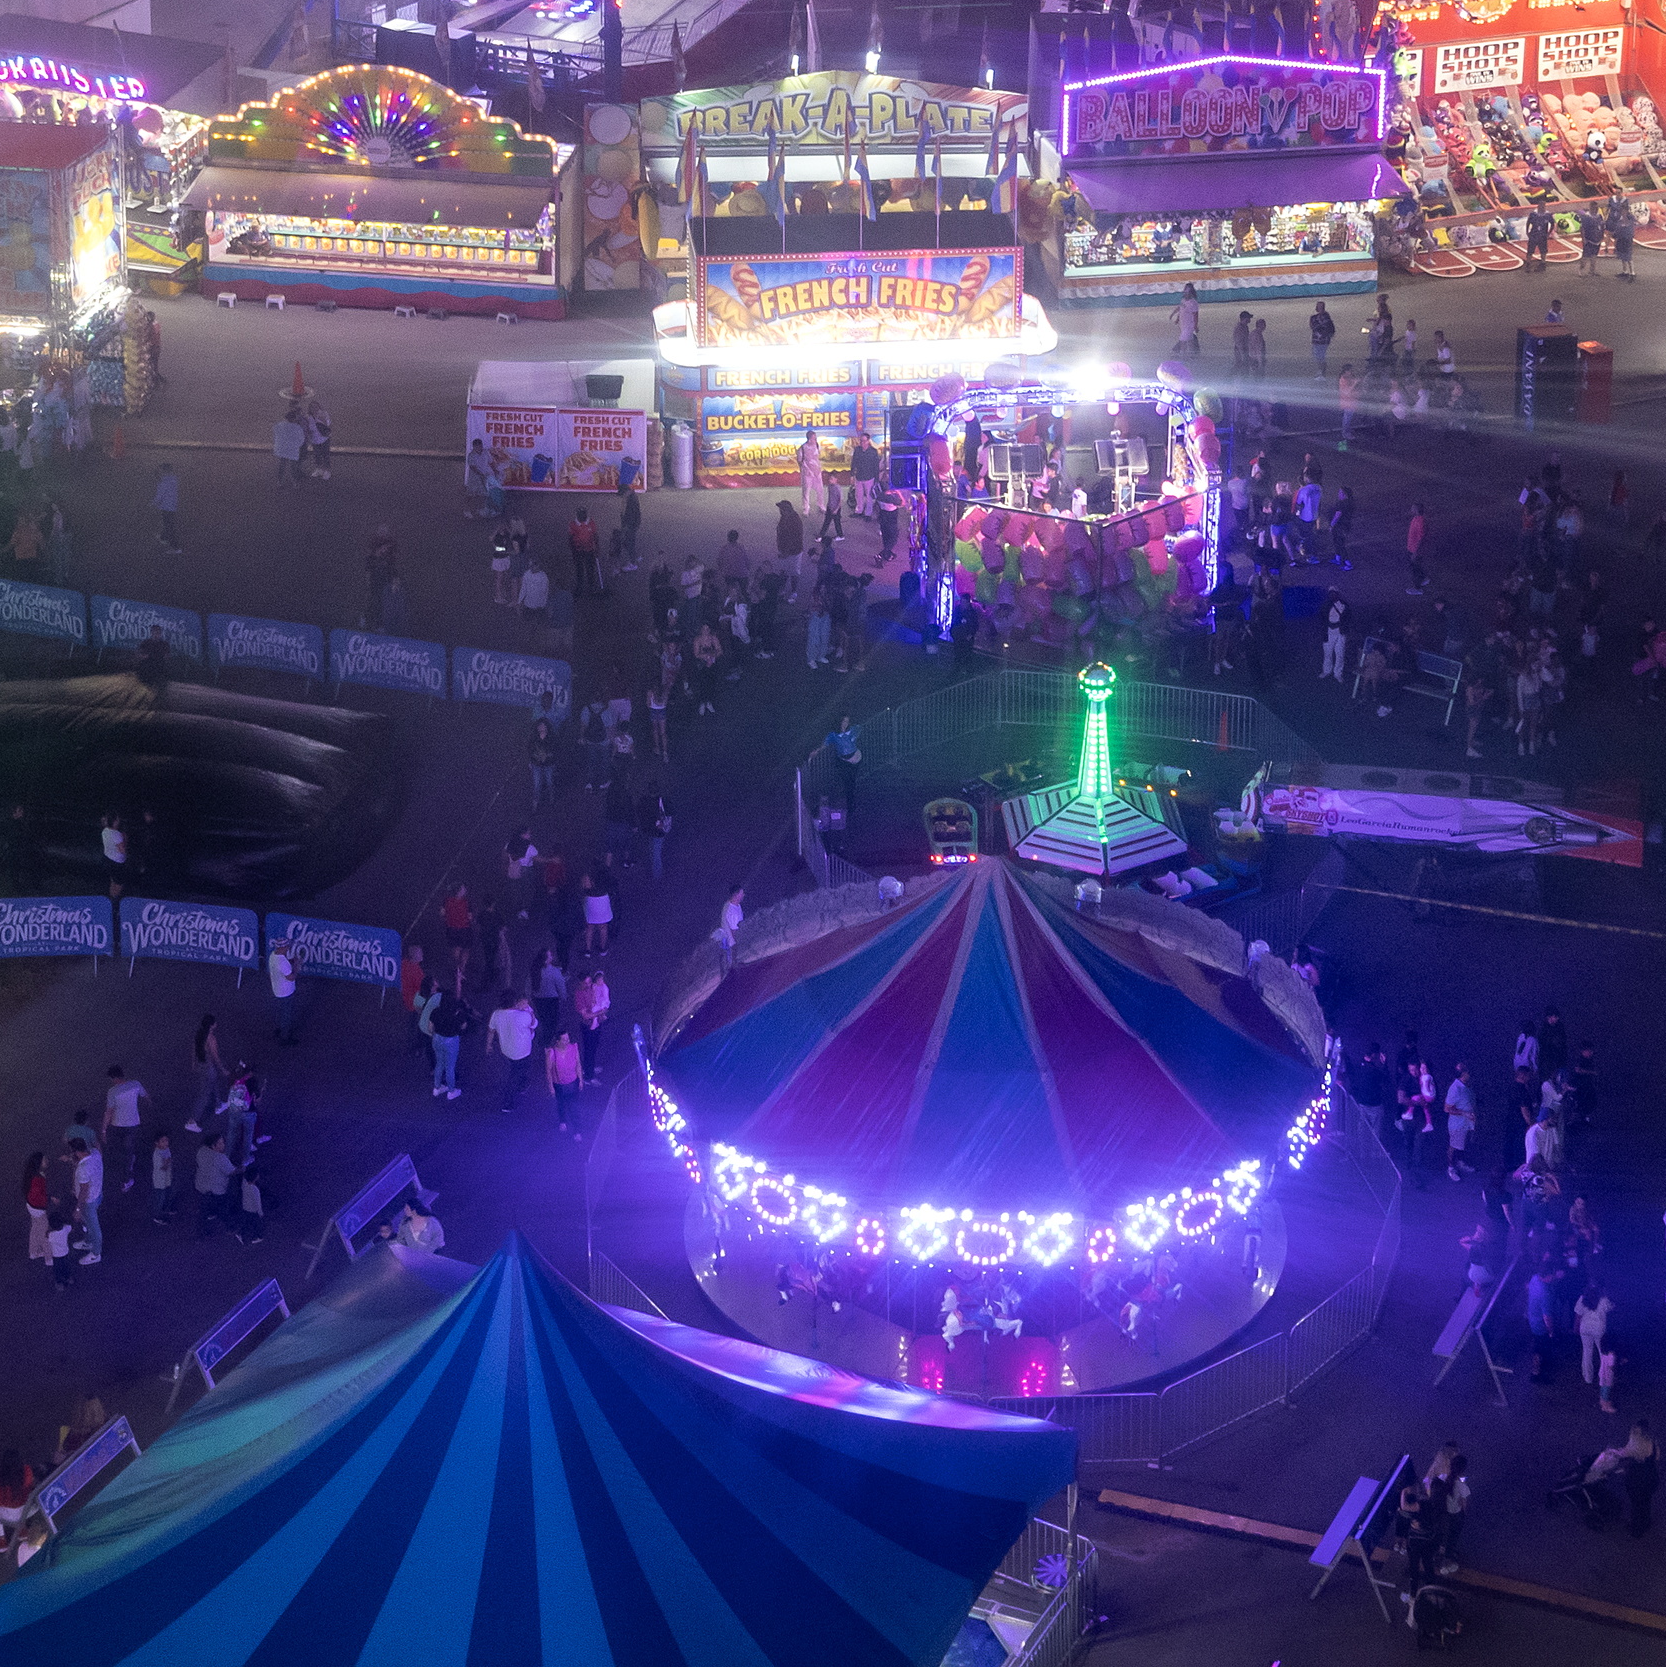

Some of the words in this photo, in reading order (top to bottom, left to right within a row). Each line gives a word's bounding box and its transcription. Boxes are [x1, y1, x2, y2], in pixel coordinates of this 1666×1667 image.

[1544, 30, 1620, 50] HOOP
[1443, 40, 1520, 61] HOOP
[1543, 45, 1618, 63] SHOTS
[1442, 56, 1519, 73] SHOTS
[677, 87, 996, 139] BREAK-A-PLATE
[1076, 86, 1263, 143] BALLOON
[1296, 79, 1376, 132] POP
[871, 261, 899, 274] Cut
[759, 275, 872, 323] FRENCH
[878, 275, 961, 316] FRIES
[716, 368, 791, 385] FRENCH
[797, 367, 851, 384] FRIES
[879, 363, 953, 380] FRENCH
[1523, 350, 1534, 415] DASANI
[485, 412, 521, 422] FRESH
[523, 413, 544, 423] CUT
[573, 415, 610, 425] FRESH
[612, 416, 632, 426] CUT
[706, 410, 851, 431] BUCKET-O-FRIES
[485, 422, 544, 436] FRENCH
[573, 426, 632, 439] FRENCH
[492, 436, 535, 449] FRIES
[580, 439, 623, 452] FRIES
[739, 447, 770, 463] CORN
[227, 620, 307, 650] Christmas
[213, 636, 319, 674] WONDERLAND
[348, 634, 430, 666] Christmas
[334, 652, 443, 691] WONDERLAND
[471, 651, 556, 683] Christmas
[142, 902, 241, 935] Christmas
[122, 921, 255, 961] WONDERLAND
[286, 919, 384, 955] Christmas
[2, 945, 51, 954] TROPICAL
[54, 944, 80, 953] PARK
[151, 947, 199, 960] TROPICAL
[202, 952, 228, 962] PARK
